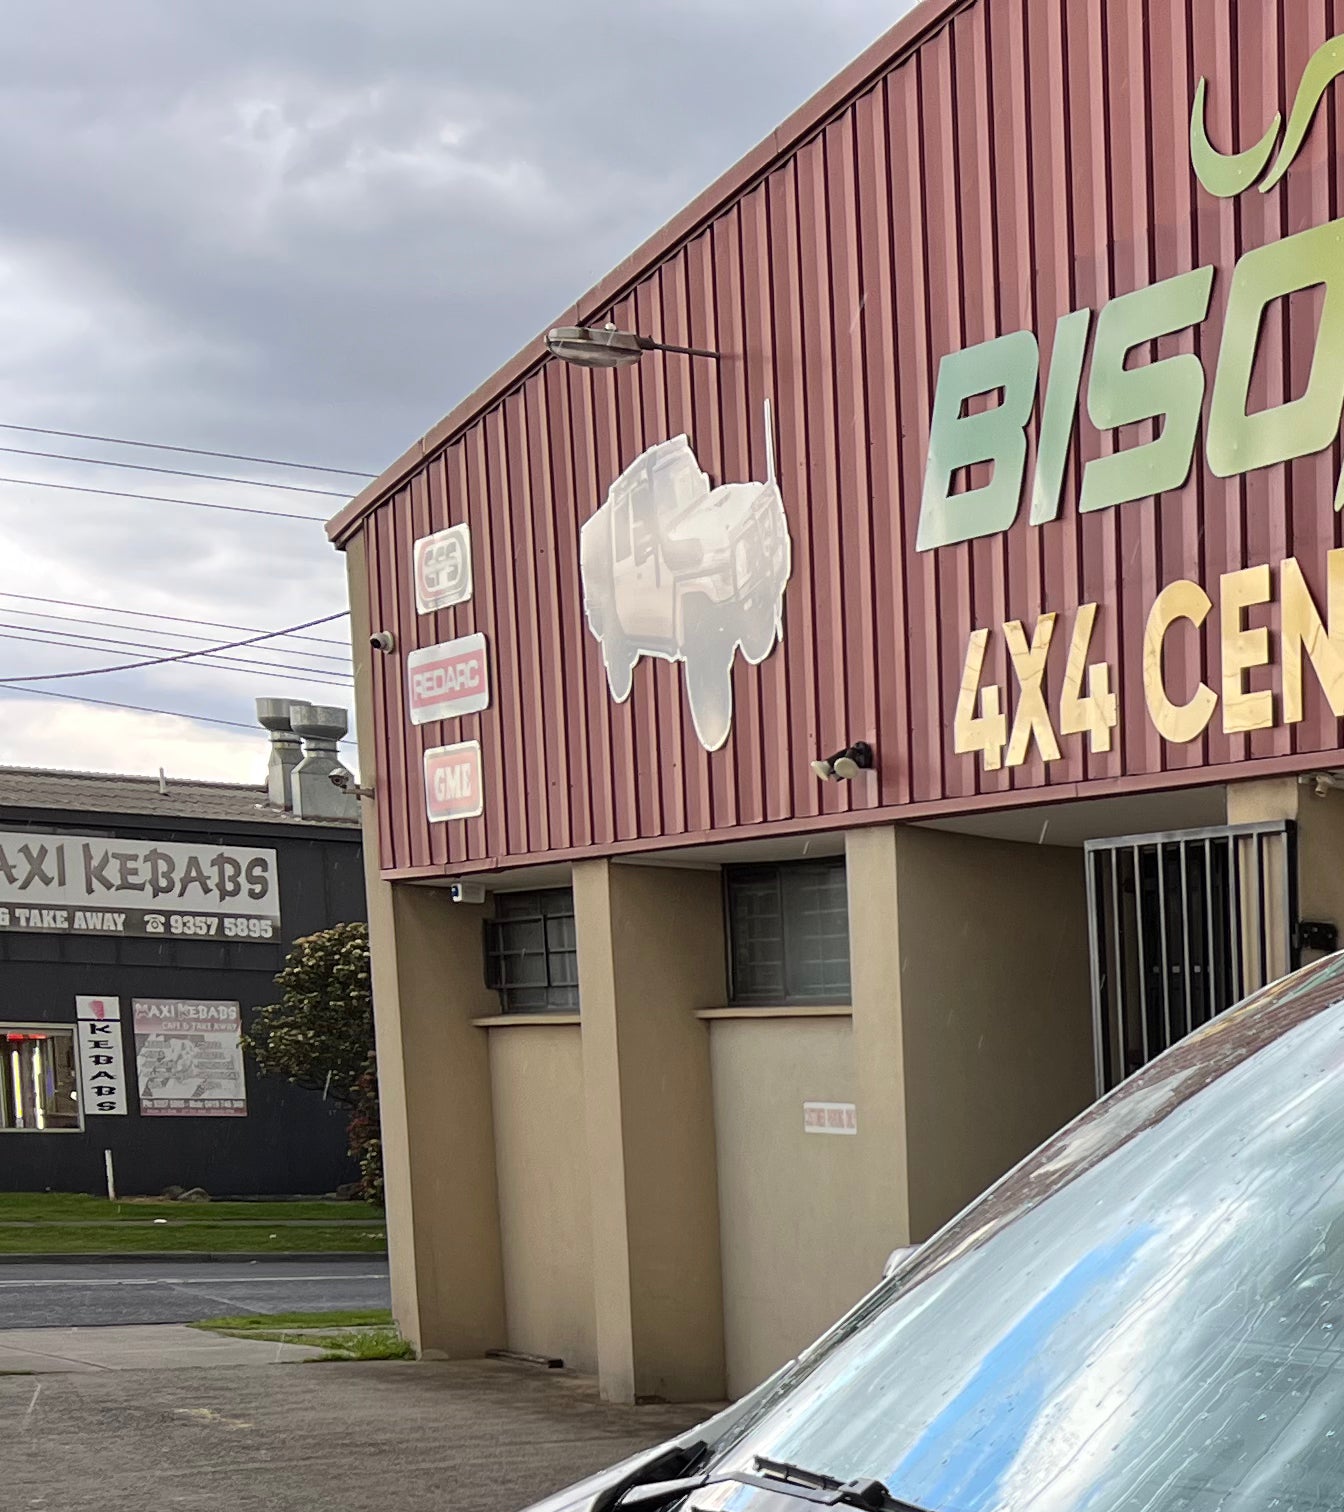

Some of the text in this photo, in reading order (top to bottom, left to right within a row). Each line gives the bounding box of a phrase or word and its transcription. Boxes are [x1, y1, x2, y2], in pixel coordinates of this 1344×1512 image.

[413, 659, 479, 701] REDARC
[954, 602, 1117, 771] 4X4
[434, 763, 472, 802] GME
[82, 842, 269, 902] KEBABS
[15, 908, 68, 929] TAKE
[73, 911, 126, 931] AWAY
[170, 914, 218, 935] 9357
[224, 917, 272, 938] 5895
[135, 1002, 237, 1019] MAXI KEBABS
[88, 1023, 117, 1111] KEBABS
